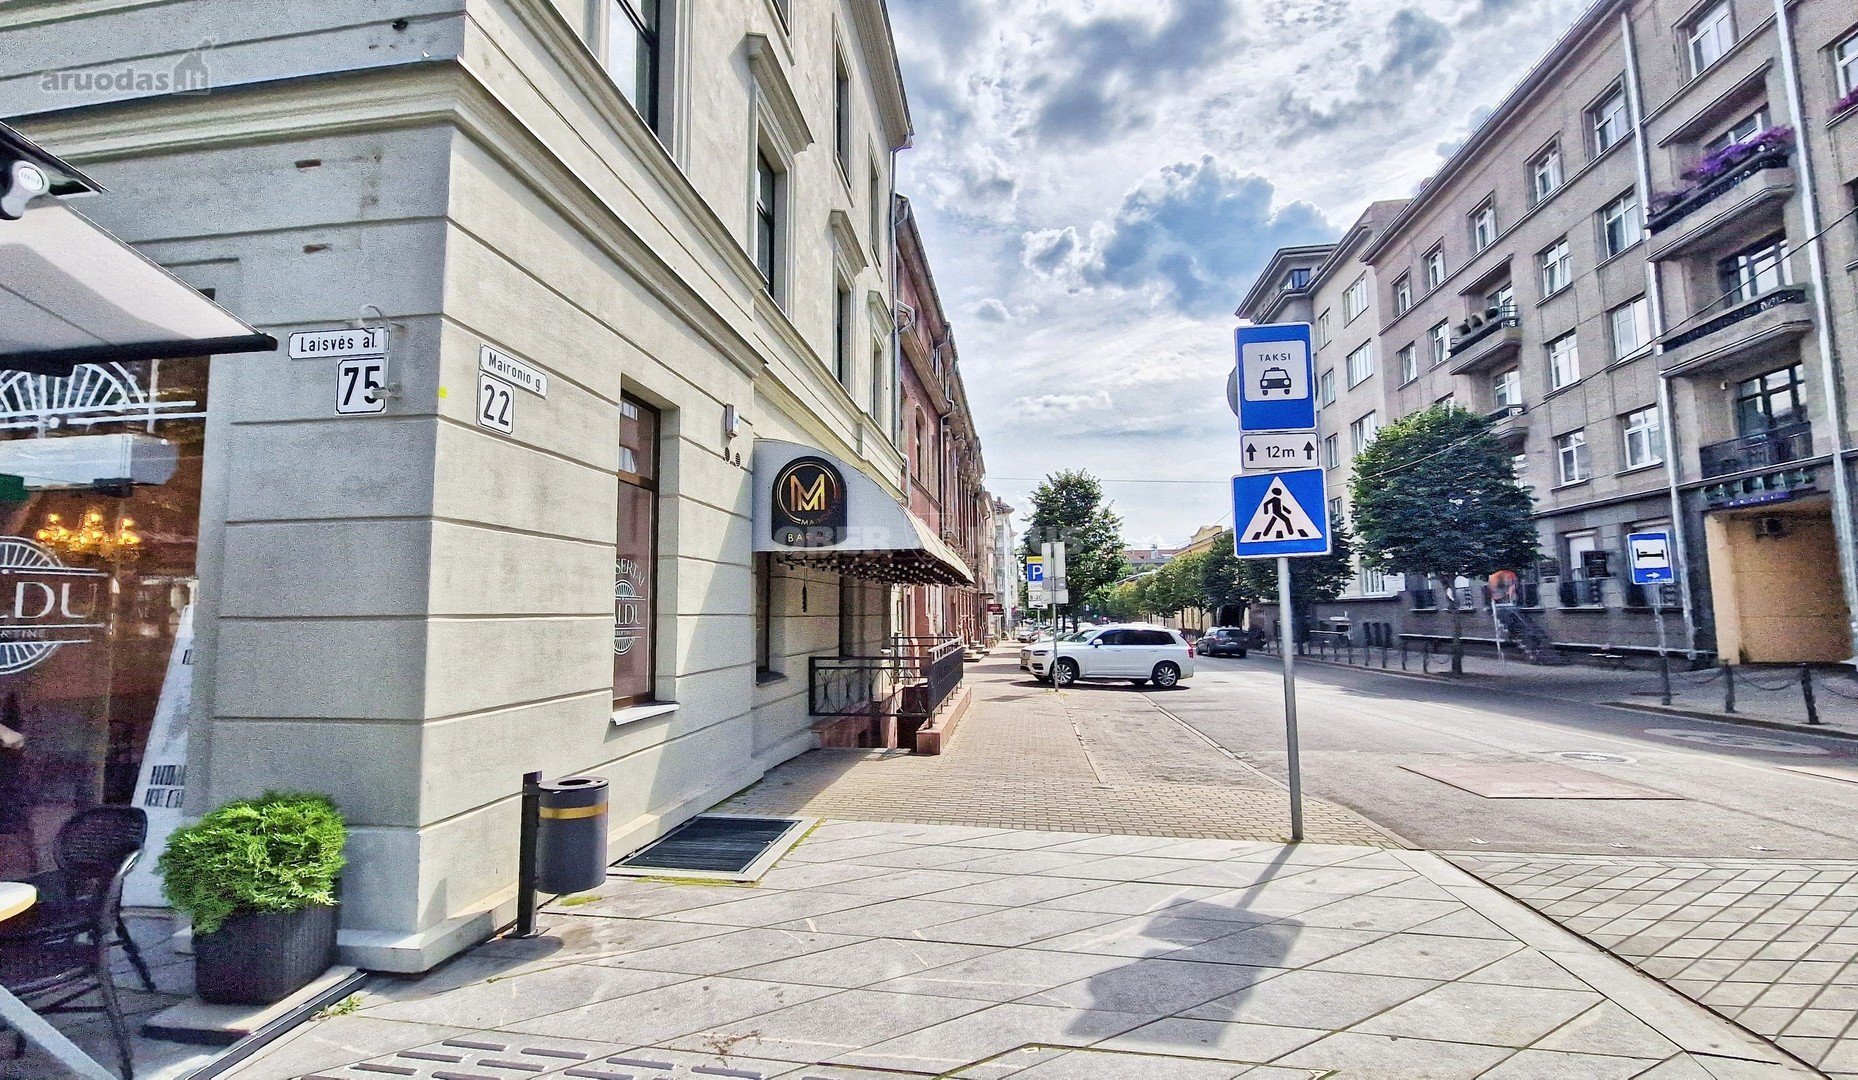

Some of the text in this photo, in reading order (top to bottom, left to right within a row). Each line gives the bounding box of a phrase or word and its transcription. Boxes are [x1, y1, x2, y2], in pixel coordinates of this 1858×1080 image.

[300, 335, 354, 352] Laisvės
[1259, 353, 1291, 362] TAKSI
[488, 352, 532, 384] Maironio
[343, 366, 380, 404] 75
[484, 384, 509, 426] 22
[1033, 565, 1042, 580] P
[0, 581, 98, 618] DU
